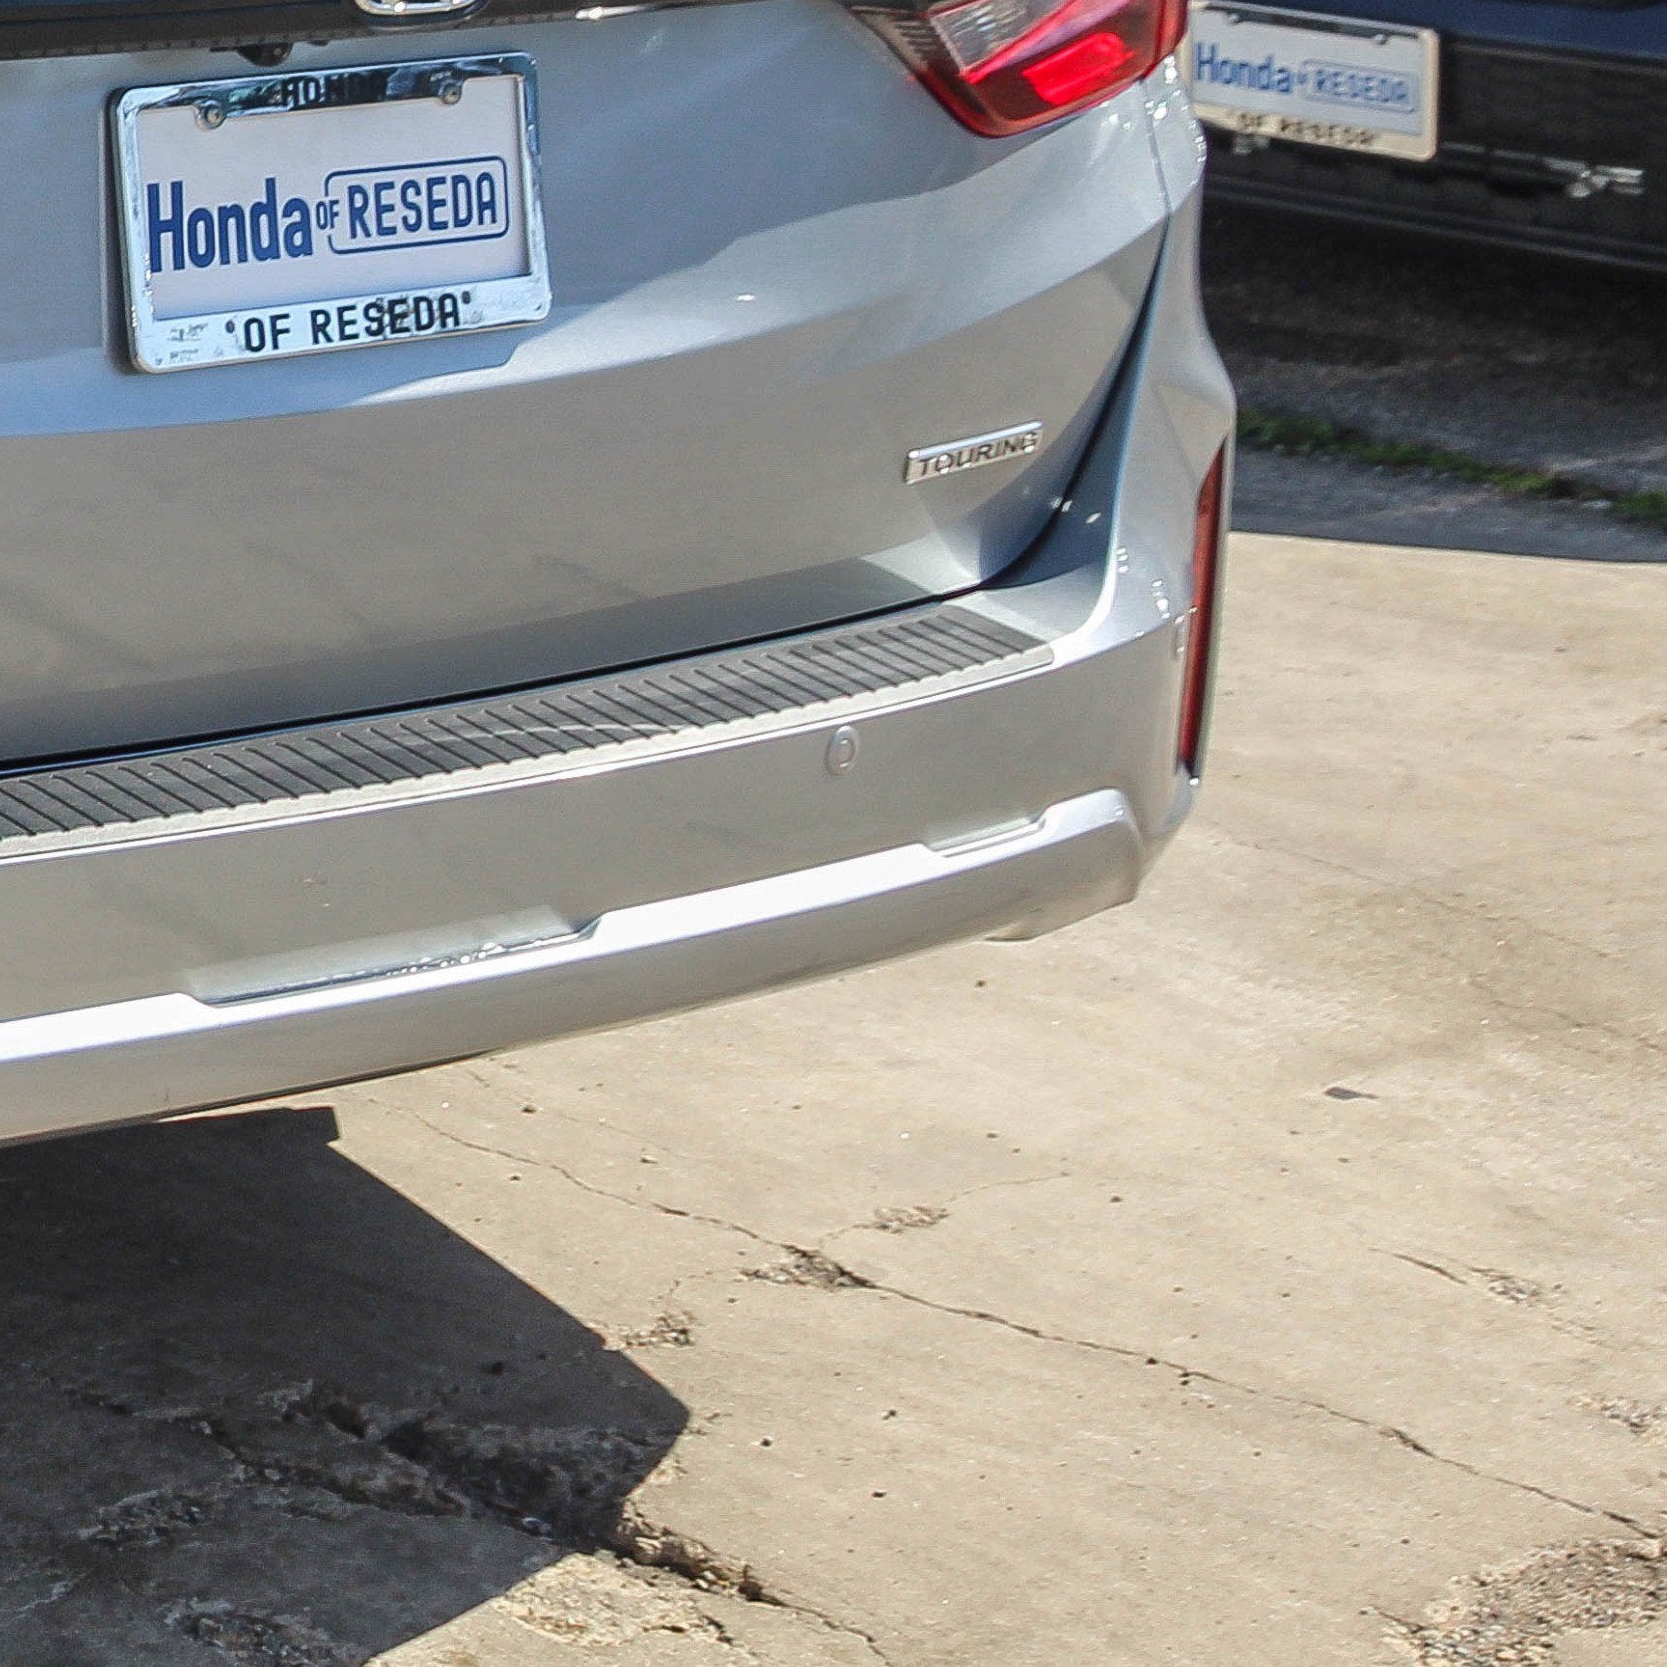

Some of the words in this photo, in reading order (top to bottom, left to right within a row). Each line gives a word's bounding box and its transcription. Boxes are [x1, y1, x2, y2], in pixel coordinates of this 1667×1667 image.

[147, 178, 314, 273] Honda
[317, 199, 341, 231] OF
[347, 172, 498, 239] RESEDA
[243, 313, 292, 353] OF
[310, 292, 462, 346] RESEDA
[919, 431, 1038, 476] TOURING
